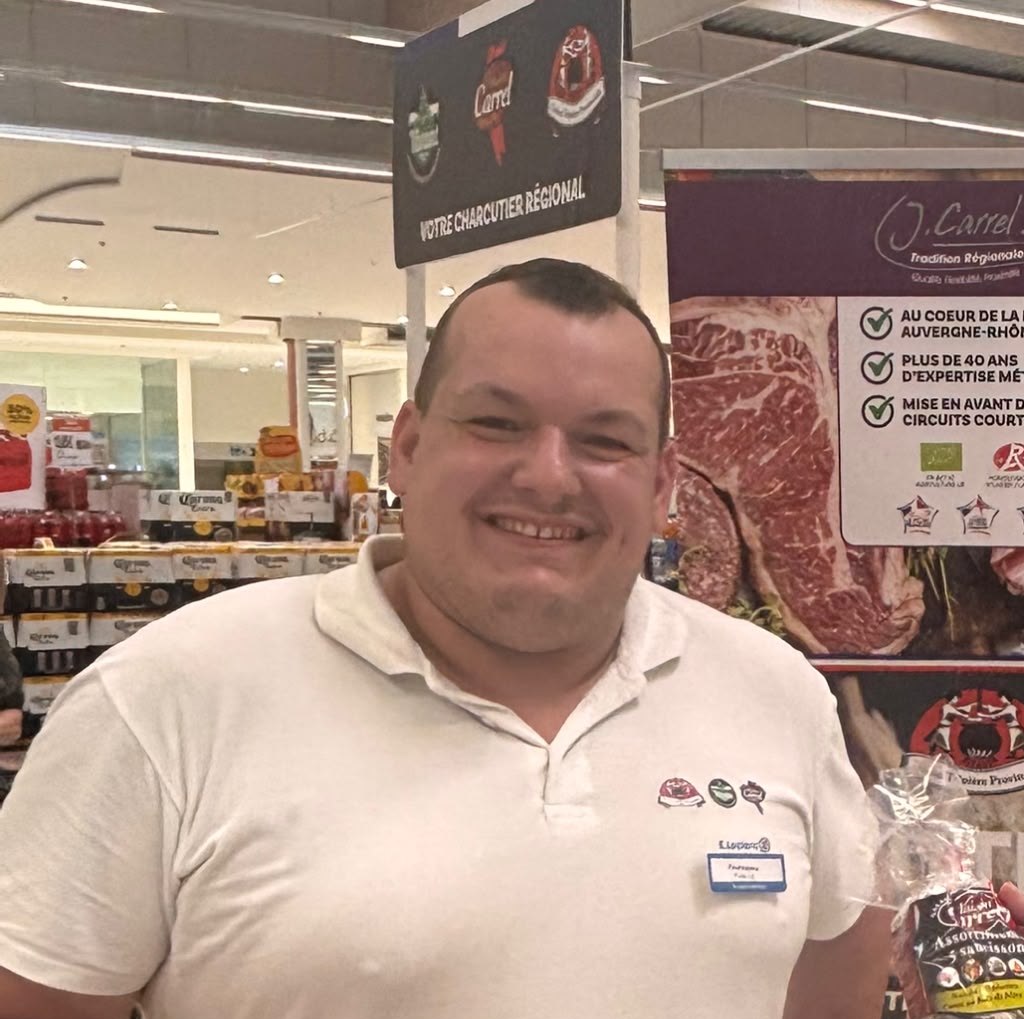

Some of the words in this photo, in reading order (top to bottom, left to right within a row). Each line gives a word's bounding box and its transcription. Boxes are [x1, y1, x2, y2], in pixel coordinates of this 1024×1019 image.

[420, 213, 453, 242] VOTRE
[454, 195, 524, 233] CHARCUTIER
[525, 175, 586, 214] RÉGIONAL
[910, 252, 961, 264] Tradition
[901, 310, 921, 322] AU
[924, 310, 976, 322] COEUR
[979, 310, 998, 322] DE
[1001, 310, 1019, 322] LA
[902, 354, 939, 367] PLUS
[942, 354, 961, 367] DE
[964, 354, 985, 367] 40
[987, 354, 1018, 367] ANS
[902, 370, 996, 383] D'EXPERTISE
[902, 398, 938, 410] MISE
[942, 398, 961, 410] EN
[963, 398, 1013, 410] AVANT
[902, 414, 971, 427] CIRCUITS
[179, 492, 223, 507] Corona
